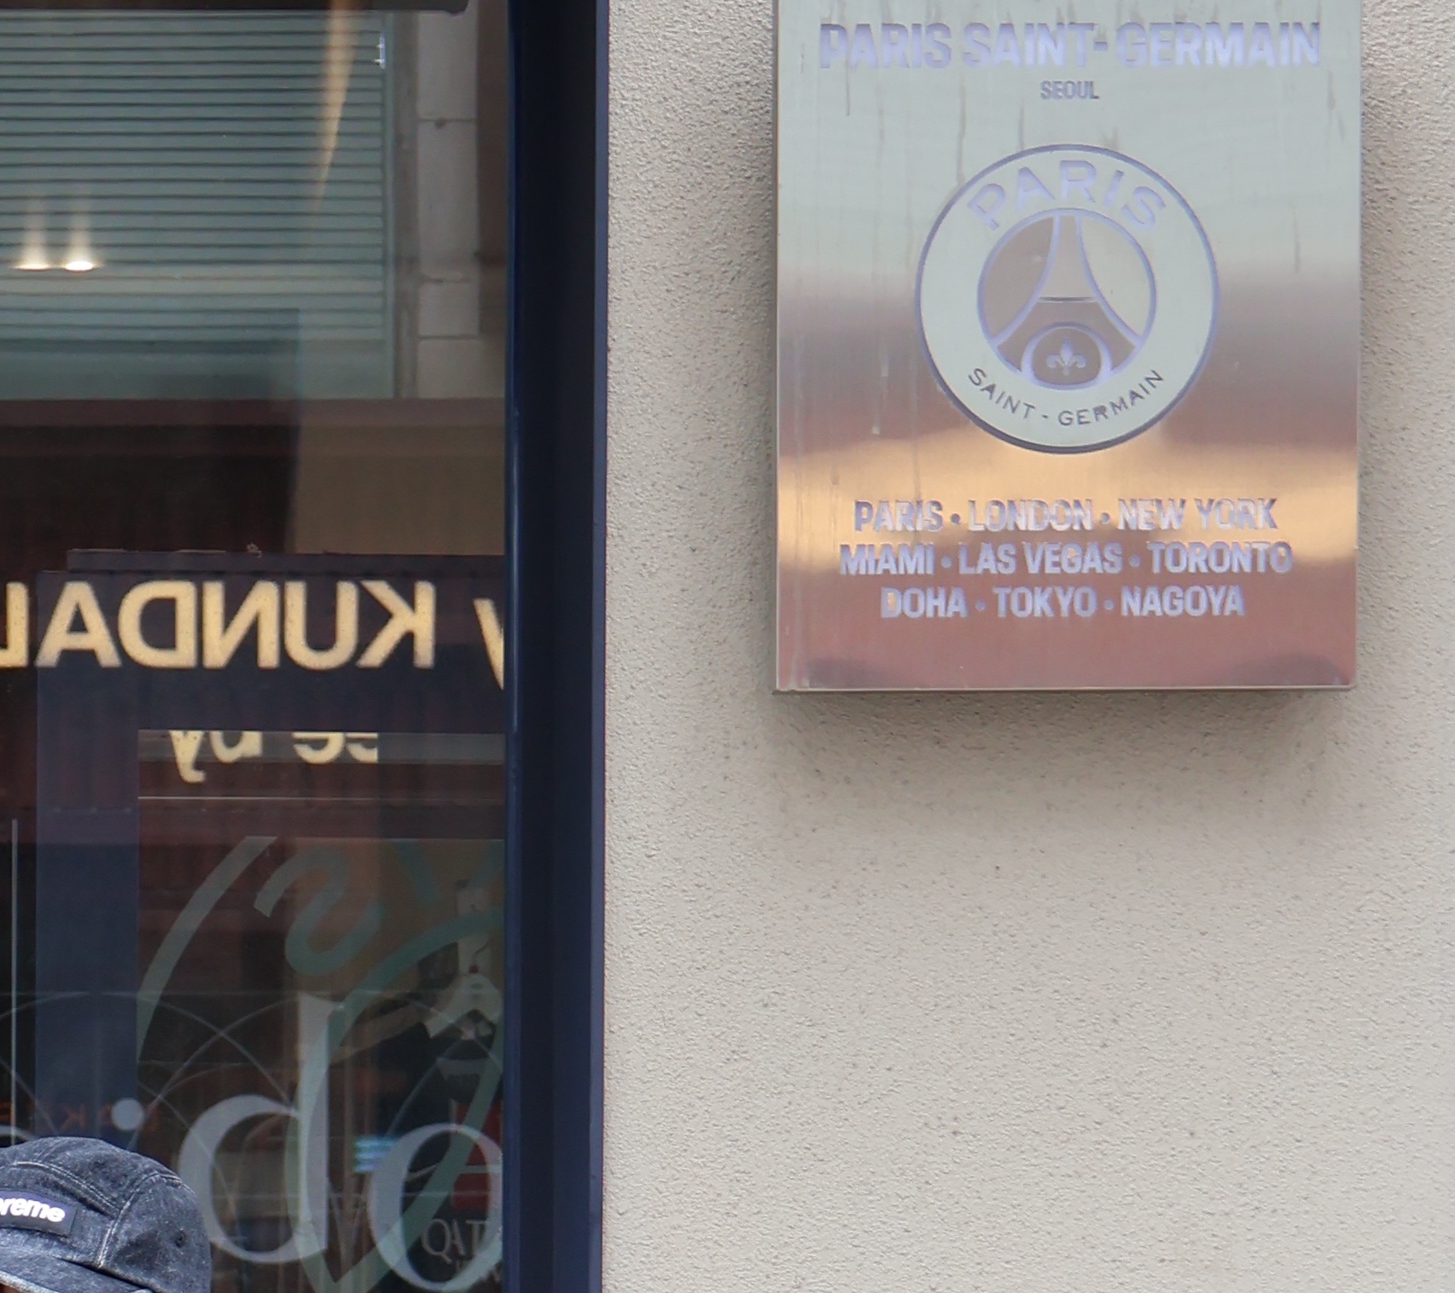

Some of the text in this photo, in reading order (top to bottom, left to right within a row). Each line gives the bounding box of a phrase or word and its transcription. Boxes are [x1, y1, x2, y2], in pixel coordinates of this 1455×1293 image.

[819, 21, 1321, 70] PARIS SAINT-GERMAIN
[1040, 80, 1100, 101] SEOUL
[966, 159, 1167, 233] PARIS
[854, 498, 1278, 532] PARIS LONDON NEW YORK
[839, 541, 1294, 575] MIAMI LAS VEGAS TORONTO
[881, 585, 1245, 618] DOHA TOKYO NAGOYA
